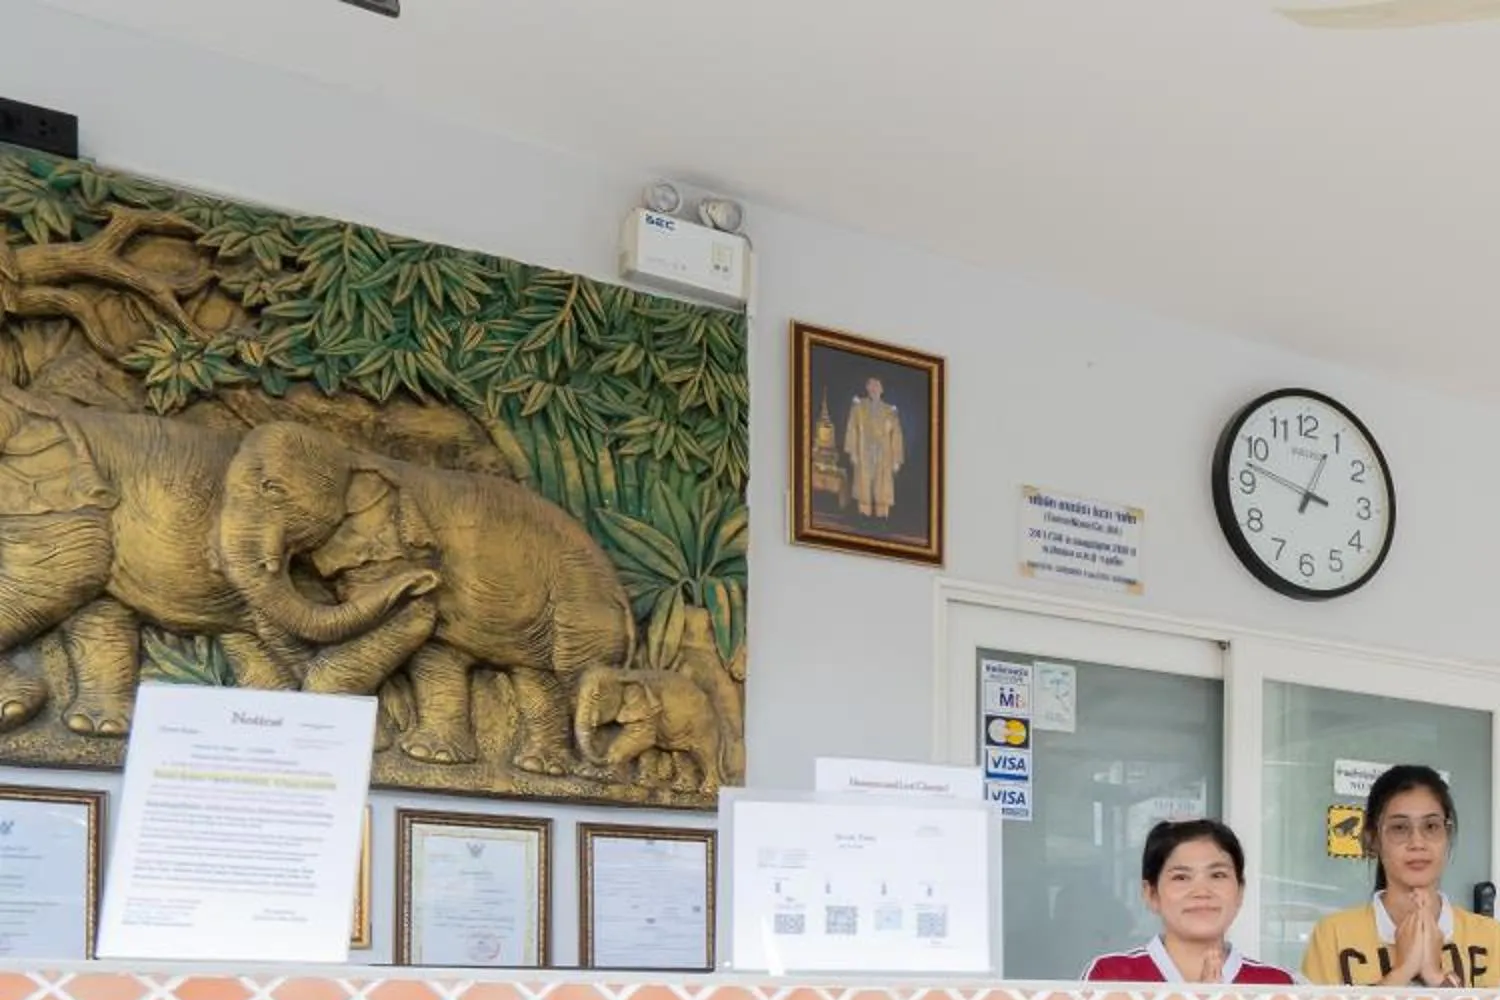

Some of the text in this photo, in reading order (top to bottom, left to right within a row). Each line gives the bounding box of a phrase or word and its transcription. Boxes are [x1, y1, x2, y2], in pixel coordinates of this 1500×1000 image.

[1270, 416, 1288, 442] 11
[1296, 414, 1319, 439] 12
[1246, 435, 1269, 462] 10
[1333, 433, 1340, 454] 1
[1239, 470, 1256, 494] 9
[1350, 459, 1365, 483] 2
[1247, 508, 1263, 533] 8
[1356, 497, 1371, 520] 3
[1271, 536, 1287, 560] 7
[1348, 529, 1364, 552] 4
[1299, 553, 1315, 577] 6
[1329, 549, 1343, 572] 5
[992, 755, 1027, 773] VISA
[992, 789, 1027, 806] VISA
